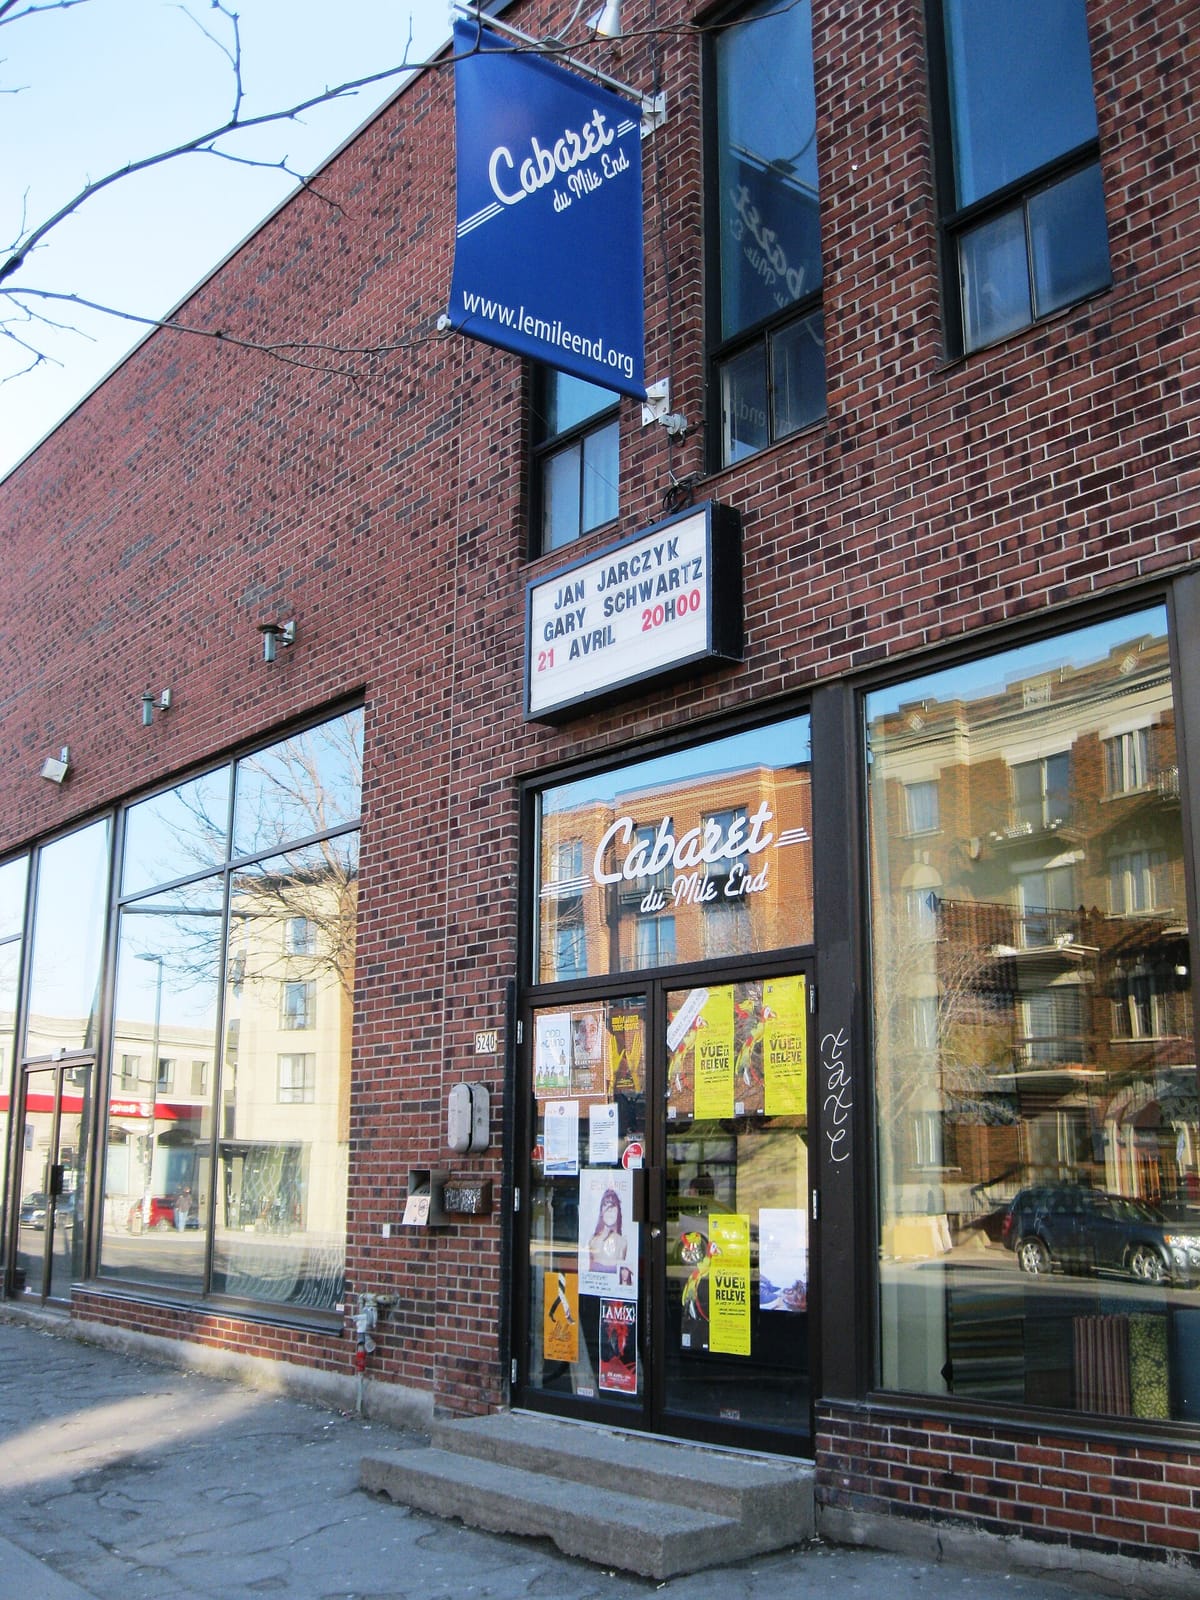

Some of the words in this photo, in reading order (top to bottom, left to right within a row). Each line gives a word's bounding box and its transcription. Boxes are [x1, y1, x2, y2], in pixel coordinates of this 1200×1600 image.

[488, 109, 615, 205] Cabaret
[553, 188, 571, 213] du
[568, 173, 602, 201] Mile
[602, 148, 630, 180] End
[463, 290, 634, 379] www.lemileend.org
[543, 606, 586, 642] GARY
[603, 556, 703, 618] SCHWARTZ
[554, 579, 585, 610] JAN
[597, 536, 679, 592] JARCZYK
[537, 648, 555, 672] 21
[568, 624, 616, 661] AVRIL
[642, 588, 701, 632] 20H00
[593, 801, 774, 885] Cabaret
[640, 889, 665, 913] du
[671, 872, 718, 907] Mile
[724, 862, 768, 896] End
[477, 1034, 495, 1052] 5240
[700, 1045, 723, 1058] VUE
[769, 1038, 795, 1051] VUE
[715, 1276, 739, 1289] VUE
